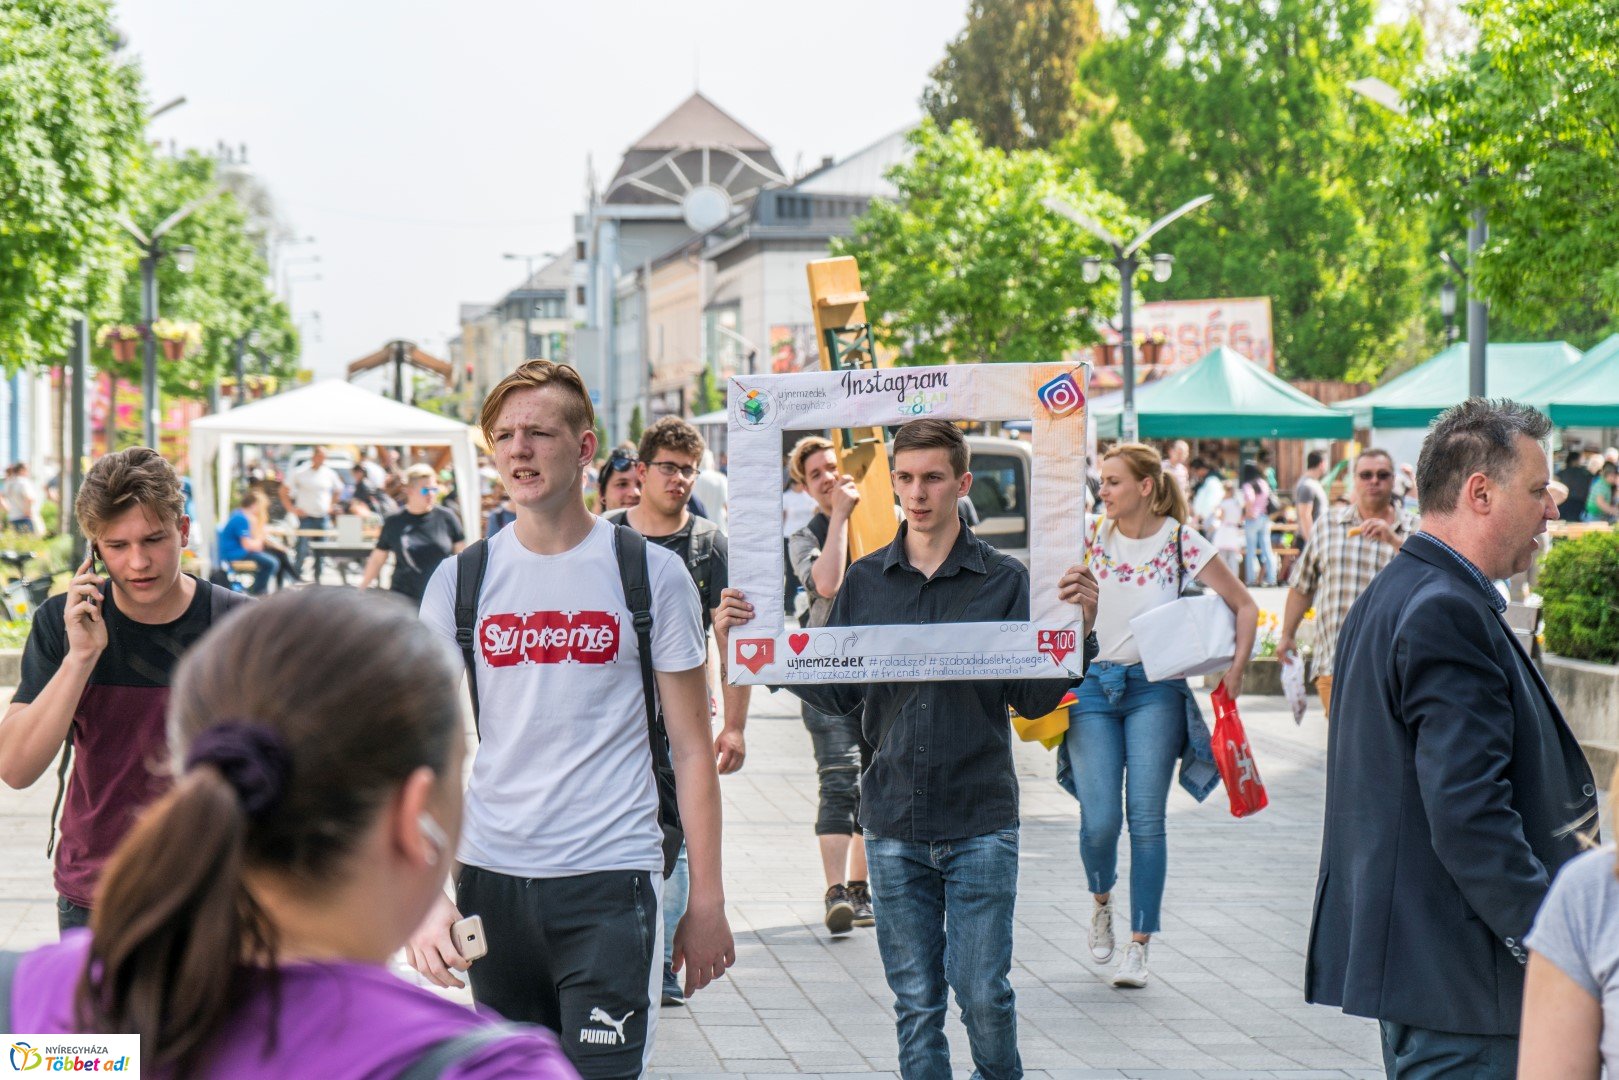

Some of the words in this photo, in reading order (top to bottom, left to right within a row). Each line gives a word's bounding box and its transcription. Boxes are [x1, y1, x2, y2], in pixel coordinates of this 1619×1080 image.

[841, 370, 948, 402] Instagram
[484, 623, 614, 656] Supreme
[1054, 631, 1075, 649] 100
[761, 644, 767, 656] 1
[871, 667, 920, 678] #friends
[580, 1028, 617, 1045] PUMA
